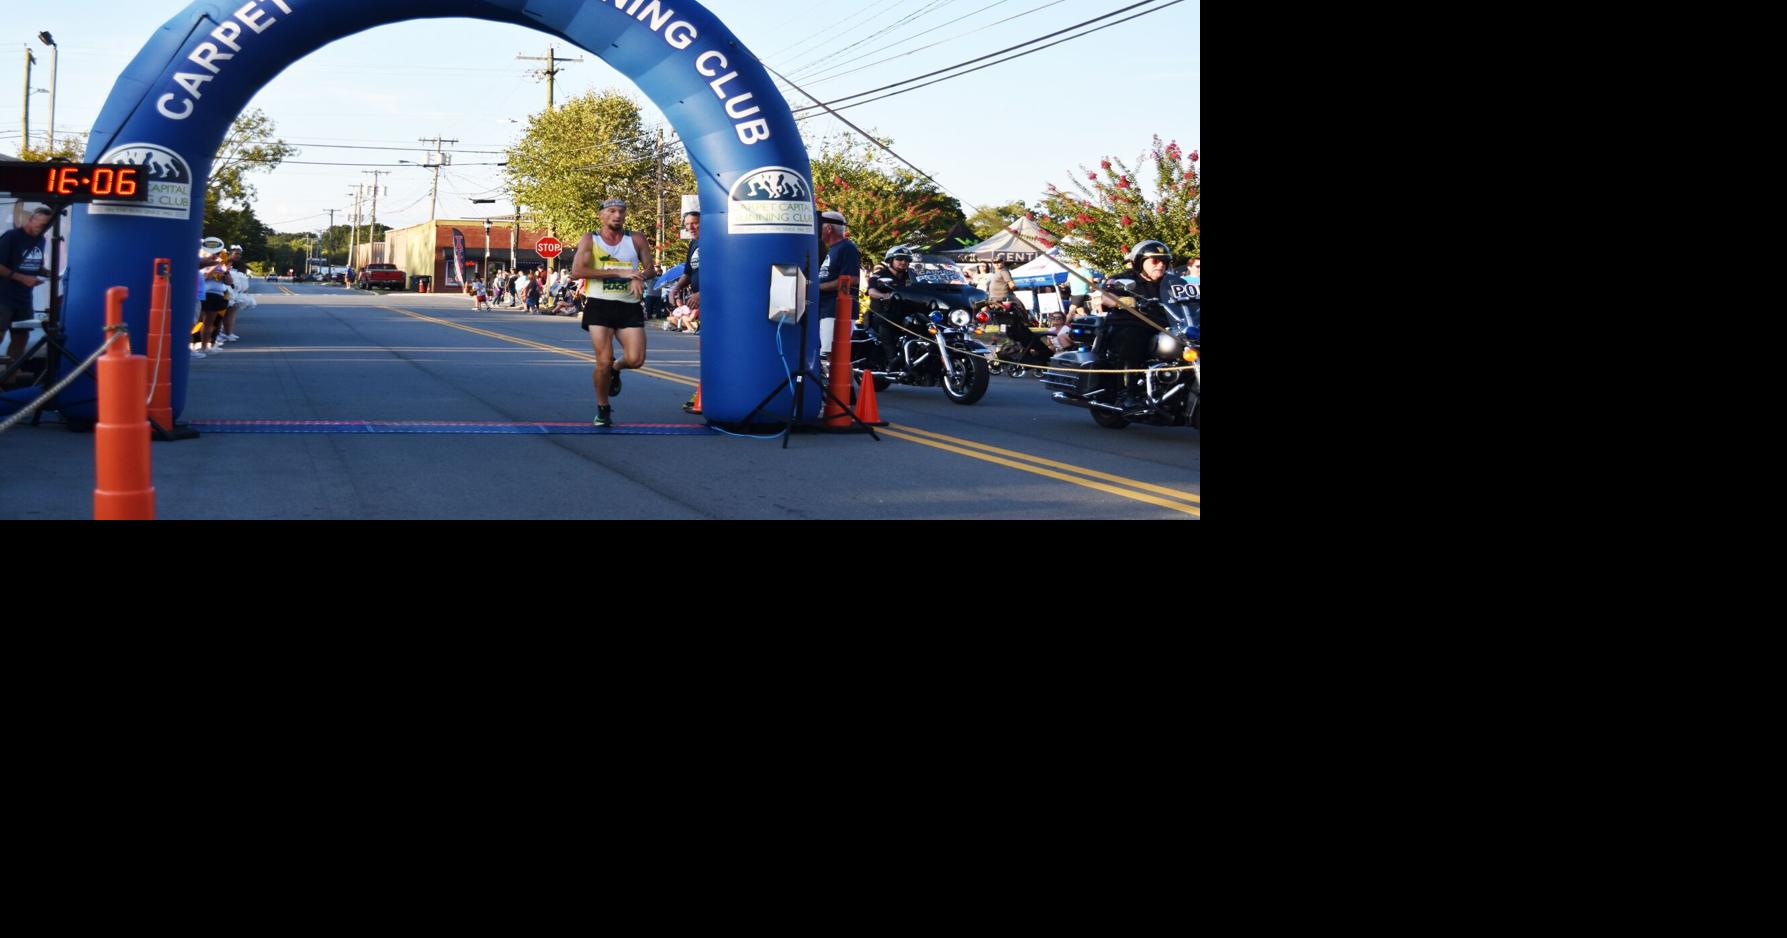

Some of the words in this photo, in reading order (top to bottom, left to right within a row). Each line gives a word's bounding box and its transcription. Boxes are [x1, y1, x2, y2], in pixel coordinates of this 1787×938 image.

[156, 0, 293, 120] CARPET
[602, 0, 698, 50] ING
[695, 50, 770, 145] CLUB
[151, 183, 188, 195] APITAL
[158, 195, 188, 207] CLUB
[537, 243, 560, 252] STOP
